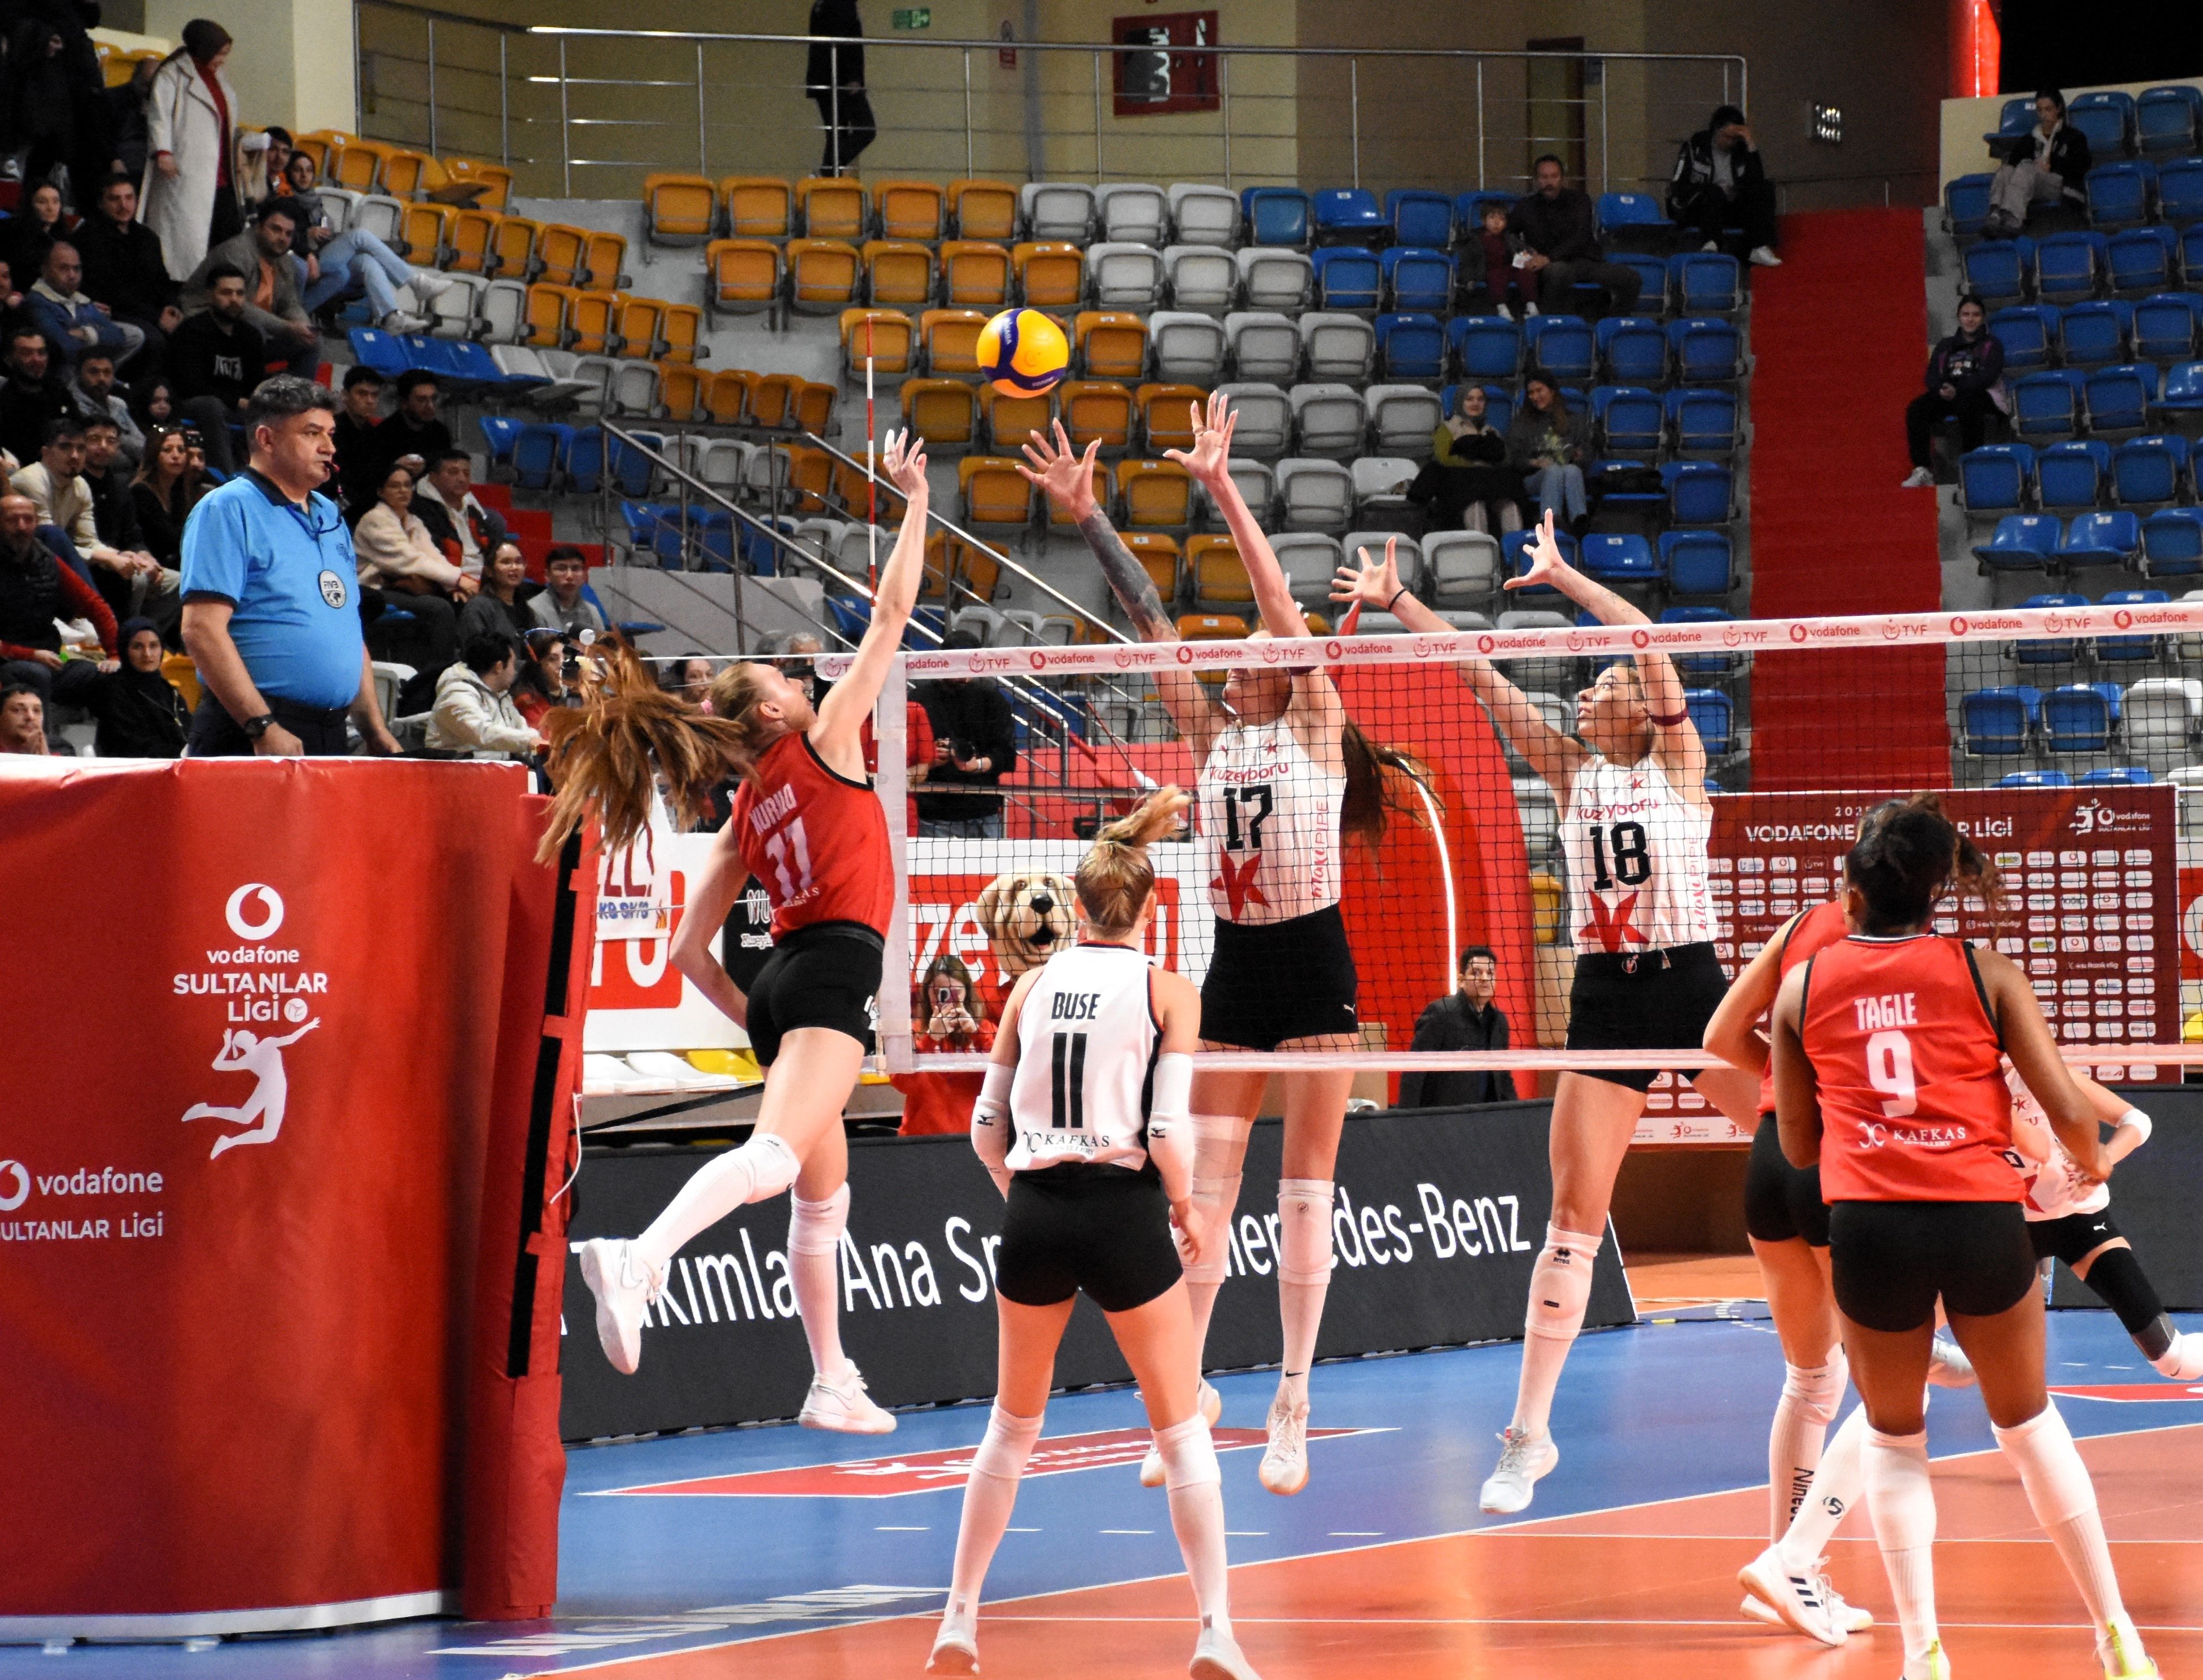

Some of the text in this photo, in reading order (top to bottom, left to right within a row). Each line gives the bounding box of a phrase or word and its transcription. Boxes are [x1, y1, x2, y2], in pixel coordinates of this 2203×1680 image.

[987, 658, 1010, 670] TVF
[1048, 653, 1095, 665] vodafone
[1133, 653, 1156, 664] TVF
[1195, 648, 1243, 660] vodafone
[1282, 648, 1305, 659] TVF
[1345, 642, 1393, 655] vodafone
[1433, 642, 1457, 654] TVF
[1496, 637, 1546, 649] vodafone
[1587, 636, 1611, 648] TVF
[1651, 631, 1702, 643] vodafone
[1742, 631, 1768, 642] TVF
[1809, 625, 1861, 637] vodafone
[1903, 624, 1928, 636] TVF
[1970, 618, 2023, 631] vodafone
[2065, 616, 2091, 628] TVF
[2135, 611, 2189, 624] vodafone
[1210, 762, 1288, 784] kuzeyboru
[1223, 784, 1273, 850] 17
[1745, 824, 1856, 842] VODAFONE
[1975, 816, 2013, 838] LİGİ
[1590, 820, 1651, 891] 18
[206, 946, 300, 964] vodafone
[172, 972, 328, 995] SULTANLAR
[228, 994, 279, 1022] LİGİ
[1051, 991, 1101, 1020] BUSE
[1854, 992, 1918, 1031] TAGLE
[1051, 1032, 1088, 1128] 11
[1866, 1029, 1918, 1118] 9
[1043, 1134, 1110, 1147] KAFKAS
[1894, 1126, 1966, 1141] KAFKAS
[37, 1166, 164, 1196] vodafone
[0, 1210, 164, 1241] ULTANLAR LİGİ
[839, 1226, 942, 1312] Ana
